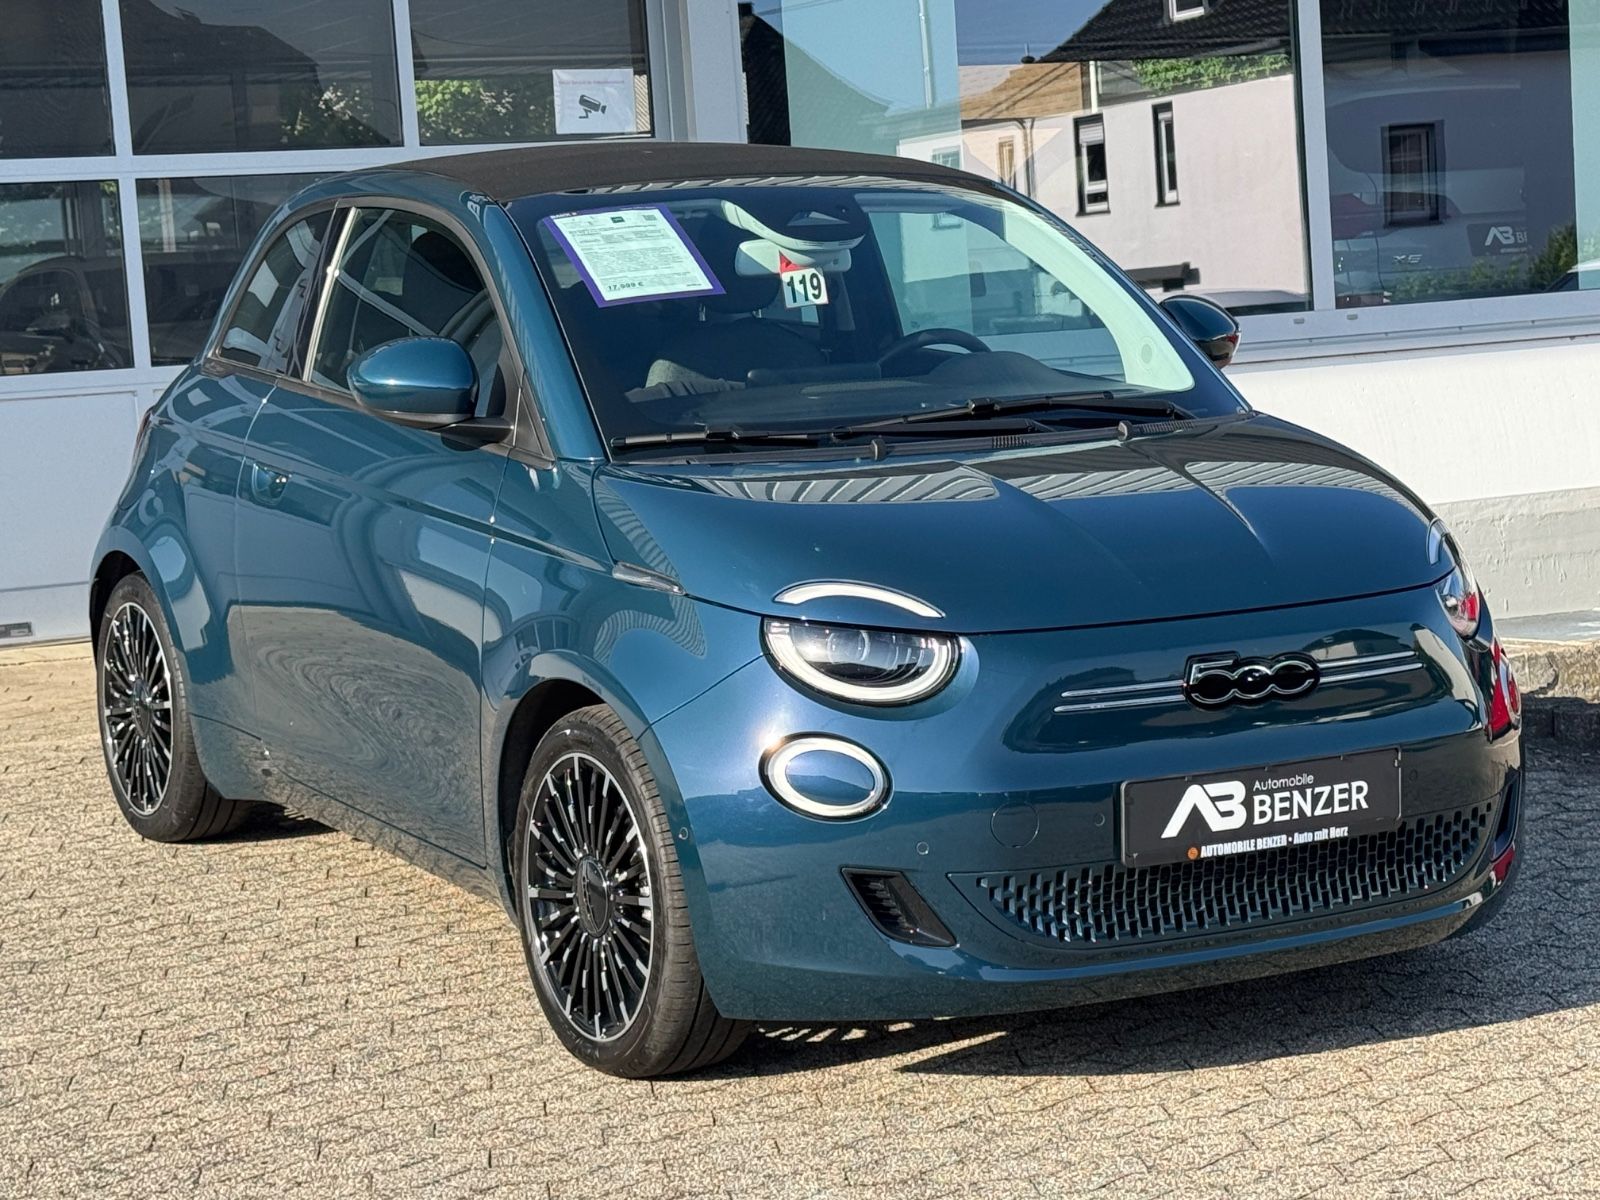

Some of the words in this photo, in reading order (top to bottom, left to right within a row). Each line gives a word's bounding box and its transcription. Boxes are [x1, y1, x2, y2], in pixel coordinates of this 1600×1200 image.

[786, 272, 823, 303] 119
[1185, 652, 1319, 709] 500
[1252, 773, 1314, 792] Automobile
[1161, 780, 1247, 839] AB
[1252, 780, 1369, 826] BENZER
[1200, 838, 1255, 858] AUTOMOBILE
[1256, 834, 1287, 850] BENZER
[1293, 832, 1313, 844] Auto
[1314, 828, 1328, 841] mit
[1329, 826, 1348, 839] Herz
